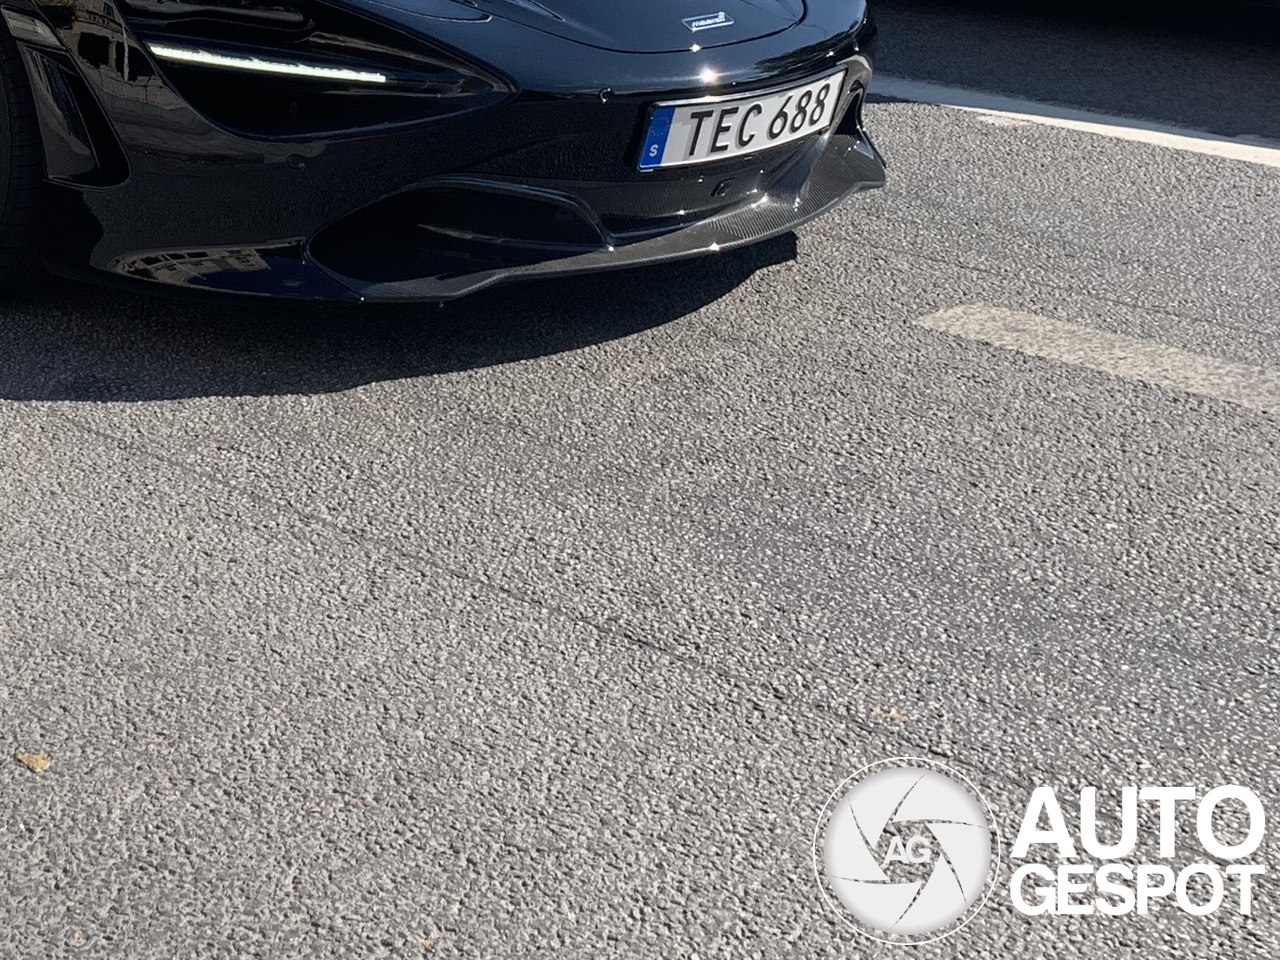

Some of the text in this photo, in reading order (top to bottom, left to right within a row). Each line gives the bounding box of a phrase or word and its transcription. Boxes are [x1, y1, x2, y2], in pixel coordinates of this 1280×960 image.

[688, 82, 831, 157] TEC 688
[648, 143, 658, 157] S
